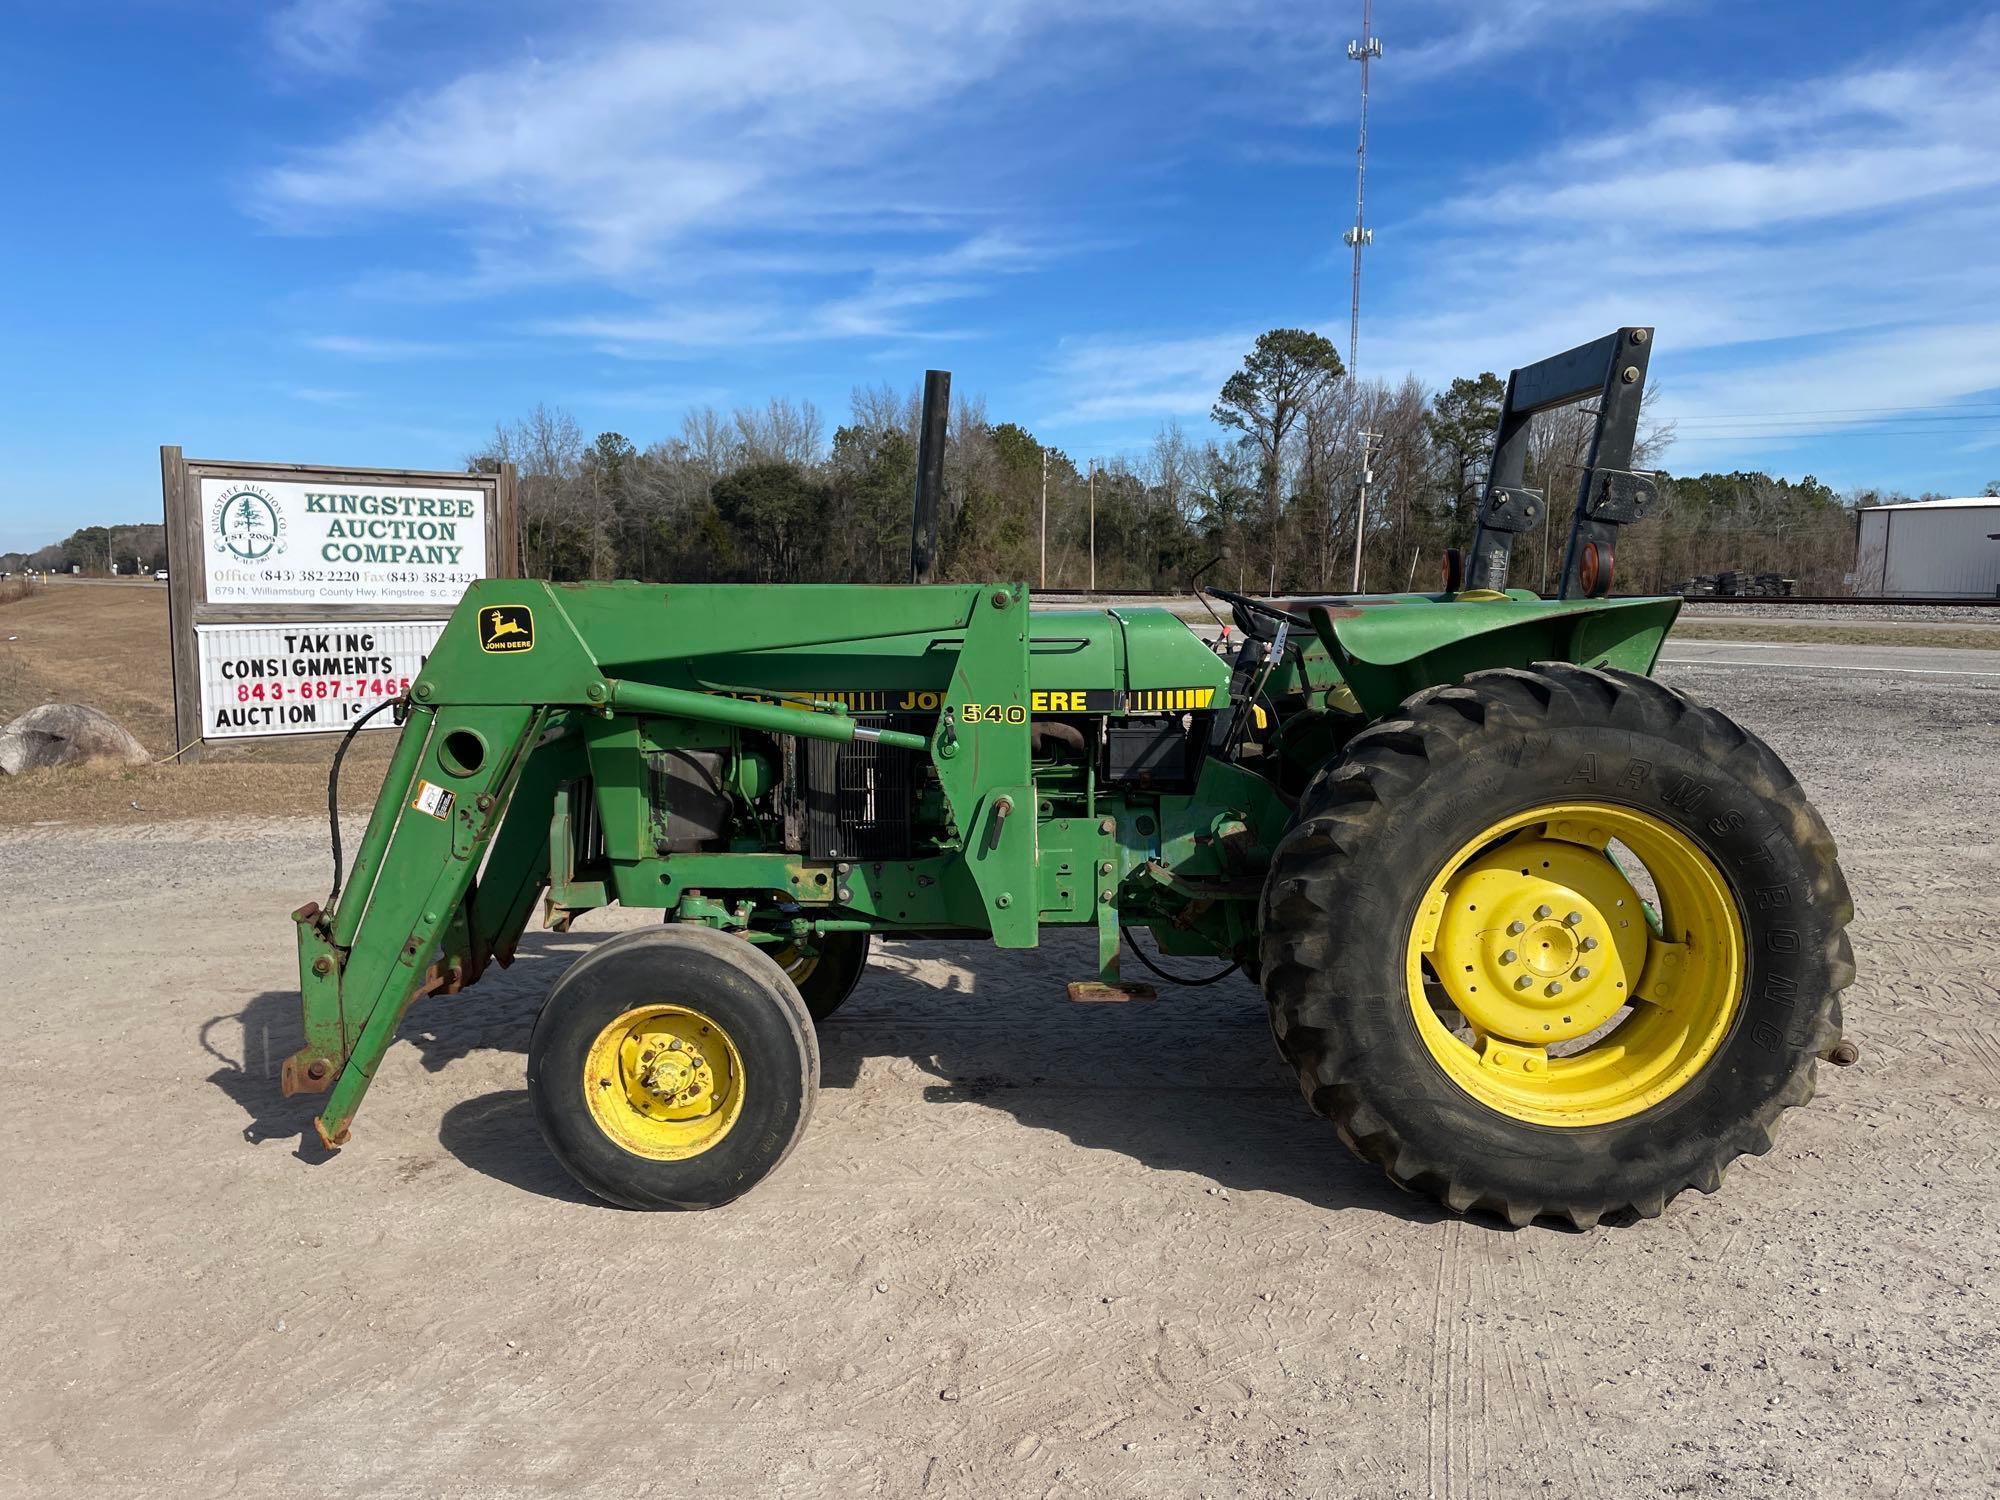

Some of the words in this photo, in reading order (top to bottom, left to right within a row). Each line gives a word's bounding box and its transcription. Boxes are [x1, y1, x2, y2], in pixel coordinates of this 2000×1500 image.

[305, 492, 474, 518] KINGSTREE
[326, 518, 457, 541] AUCTION
[321, 543, 463, 565] COMPANY
[214, 569, 256, 582] Office
[260, 570, 295, 582] (843)
[298, 570, 360, 583] 382-2220
[363, 571, 385, 582] Fax
[386, 572, 418, 584] (843)
[252, 587, 315, 598] Williamsburg
[319, 587, 353, 598] County
[381, 587, 425, 599] Kingstree
[284, 634, 375, 654] TAKING
[485, 642, 506, 650] JOHN
[507, 641, 531, 649] DEERE
[221, 657, 393, 679] CONSIGNMENTS
[216, 704, 317, 727] AUCTION
[962, 703, 1026, 724] 540
[1564, 752, 1802, 1053] ARMSTRONG
